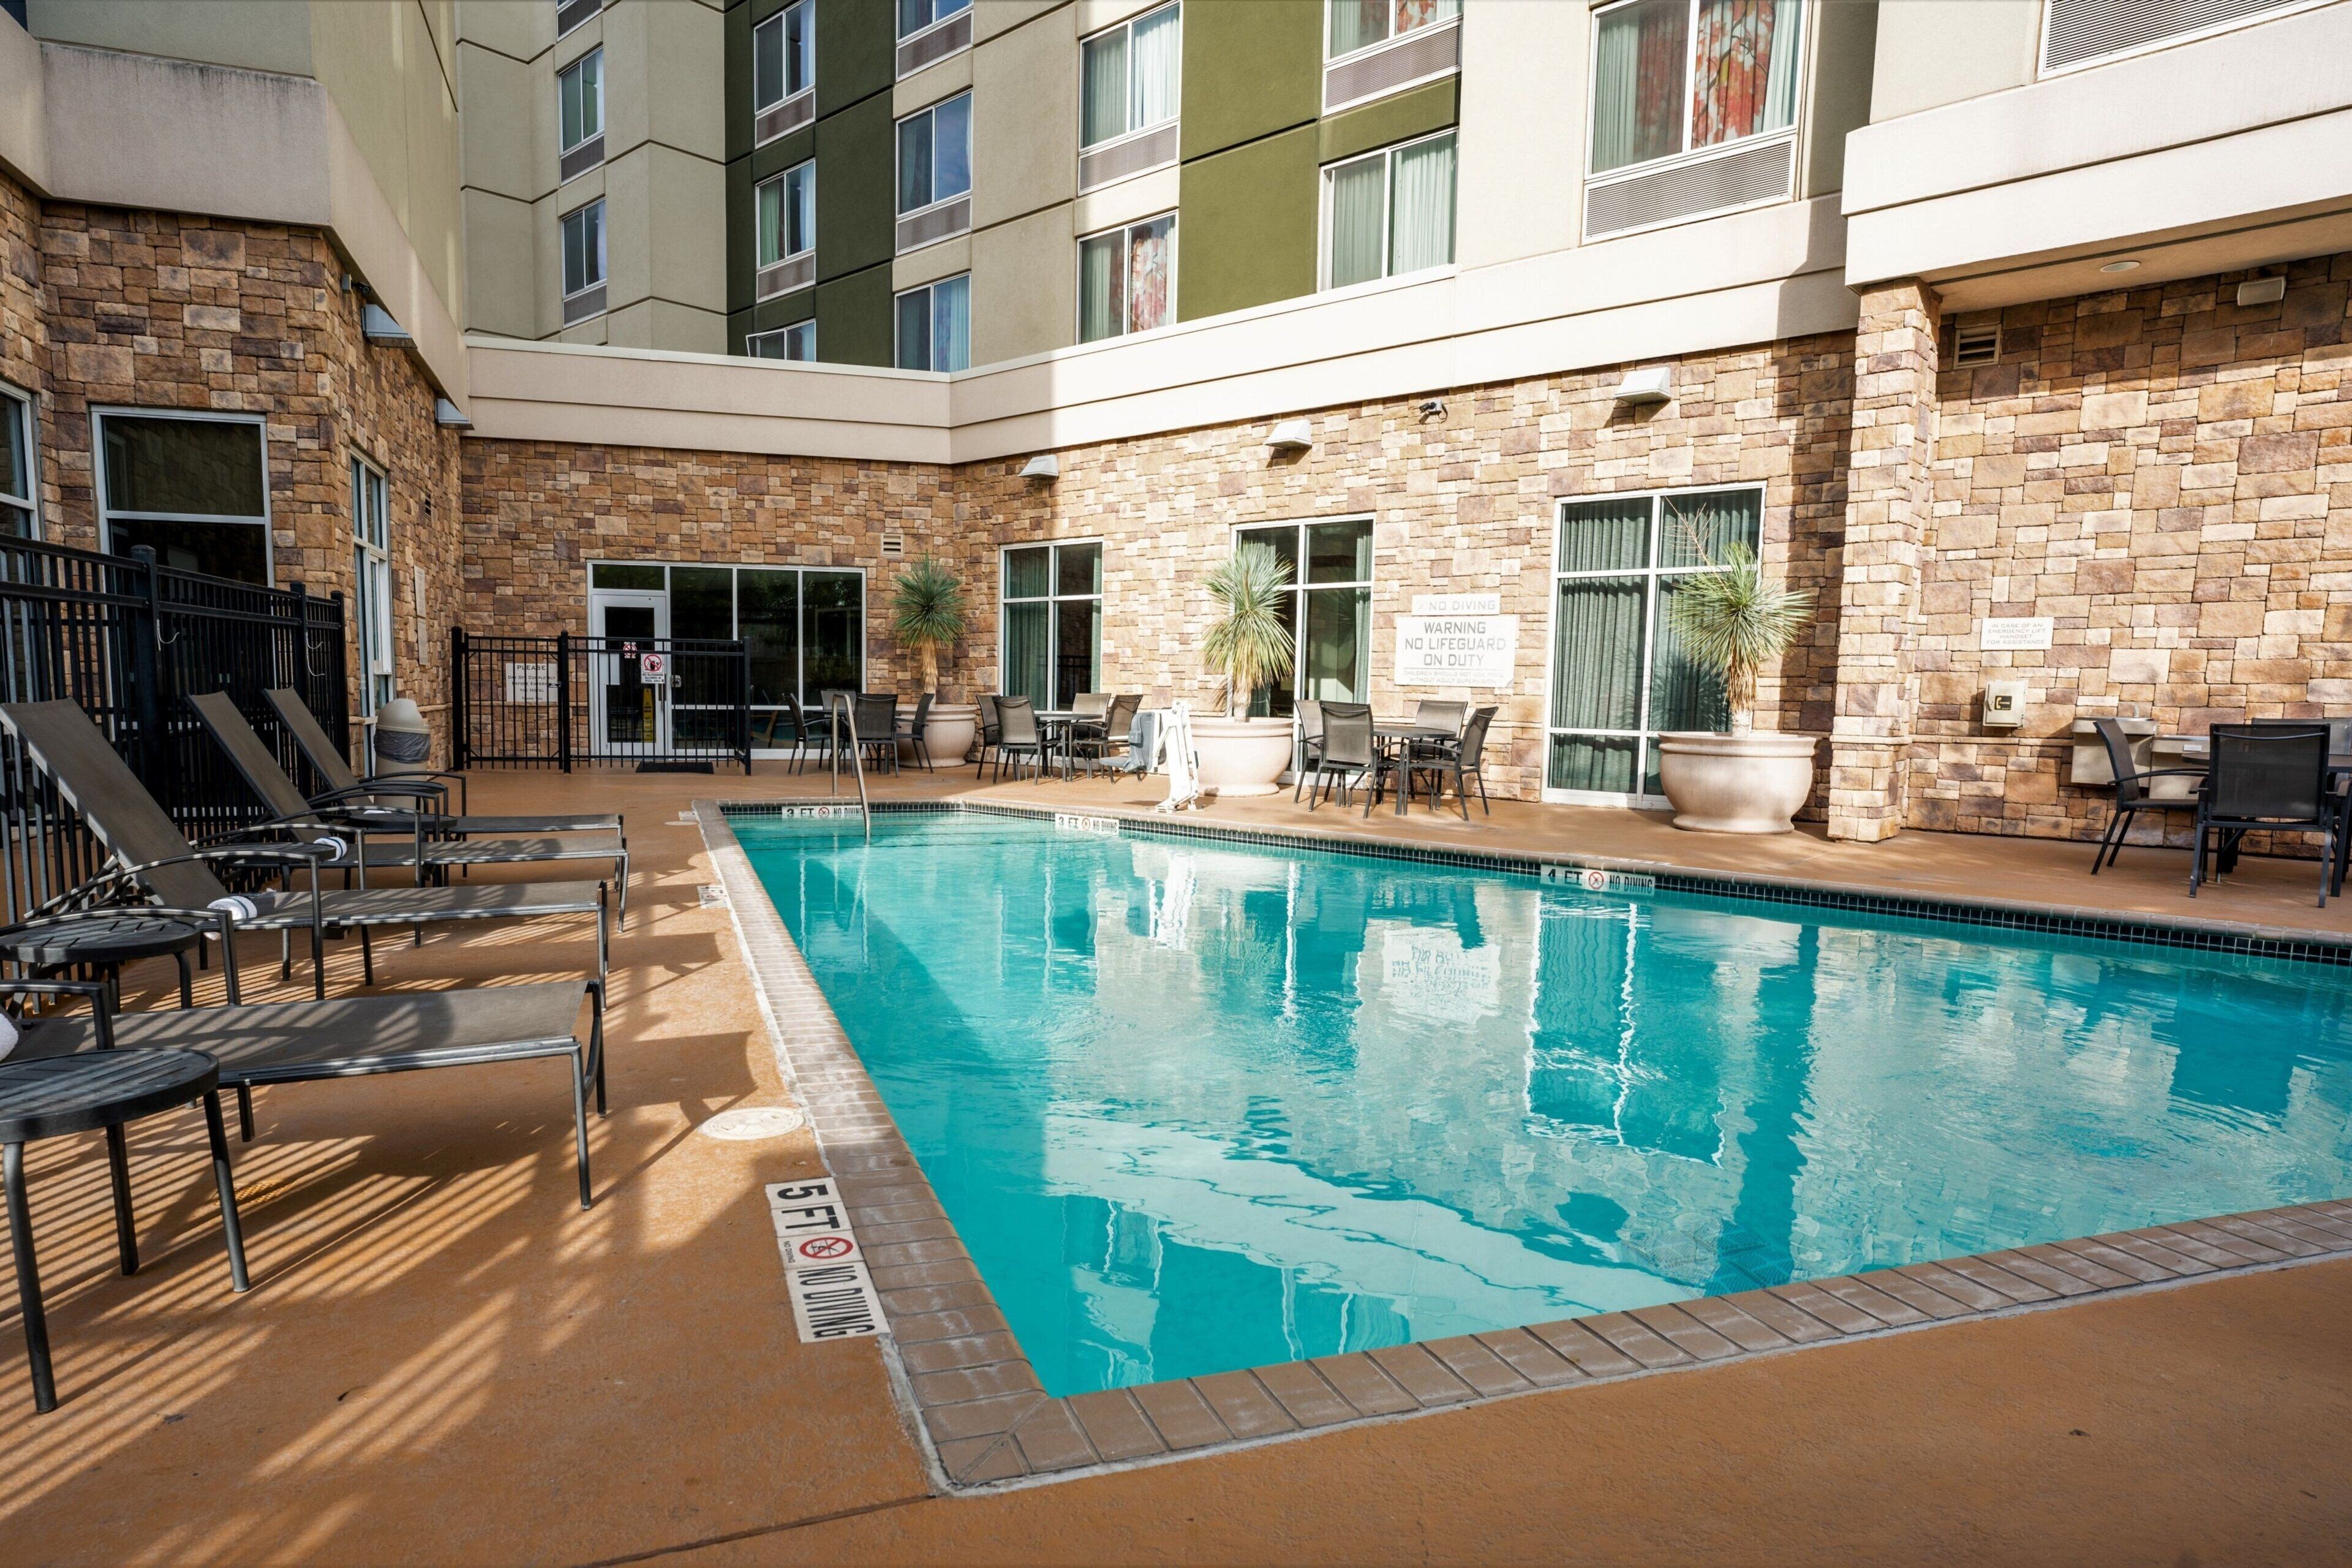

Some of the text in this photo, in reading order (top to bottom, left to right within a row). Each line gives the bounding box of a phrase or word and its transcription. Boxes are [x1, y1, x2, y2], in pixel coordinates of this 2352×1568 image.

[1428, 600, 1496, 611] NO DIVING
[1424, 622, 1486, 634] WARNING
[1405, 638, 1506, 650] NO LIFEGUARD
[1423, 654, 1484, 666] ON DUTY
[834, 807, 842, 816] NO
[1609, 875, 1620, 888] NO
[1624, 876, 1653, 892] DIVING
[777, 1184, 840, 1229] 5 FT
[785, 1248, 795, 1263] DIVING
[797, 1265, 875, 1338] NO DIVING
